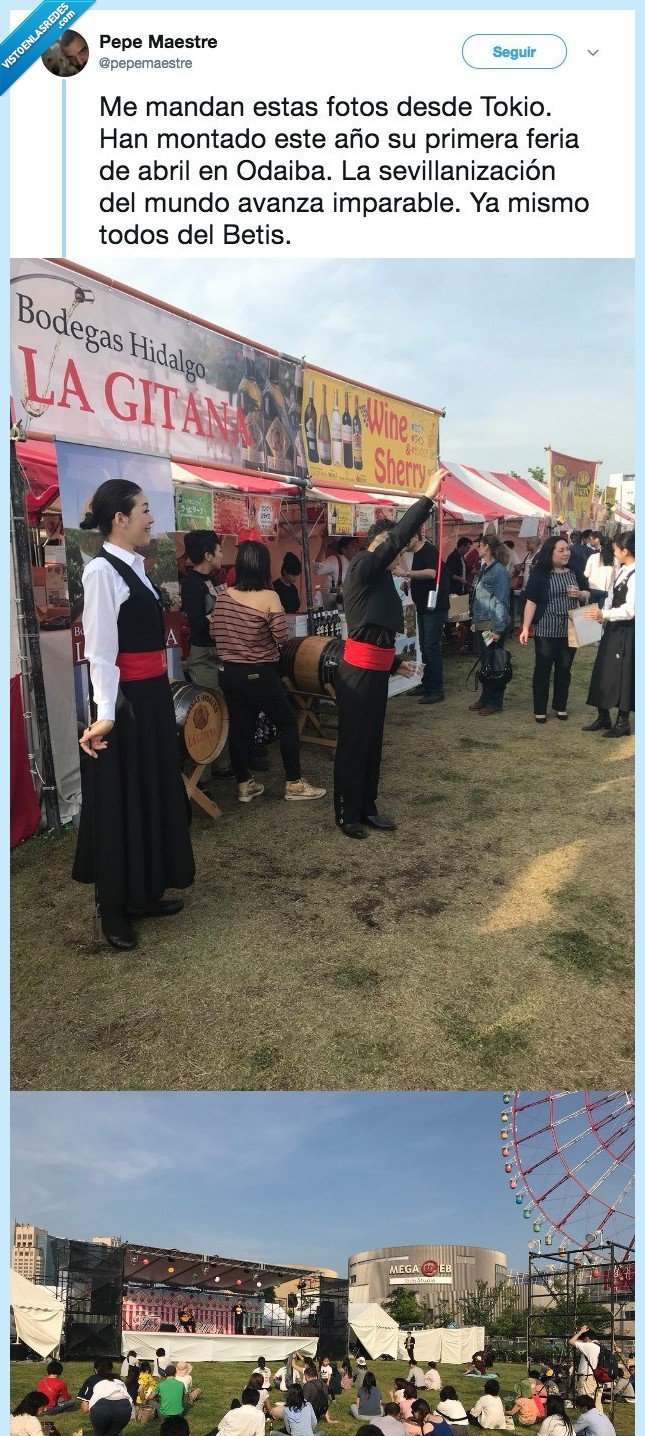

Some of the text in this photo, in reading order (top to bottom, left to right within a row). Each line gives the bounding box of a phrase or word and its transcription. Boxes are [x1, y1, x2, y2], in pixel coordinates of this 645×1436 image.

[16, 292, 206, 383] Bodegas Hidalgo
[18, 345, 252, 447] LA GITANA
[366, 396, 408, 442] Wine
[374, 446, 426, 489] Sherry
[75, 642, 87, 662] L
[389, 1264, 420, 1275] MEGA
